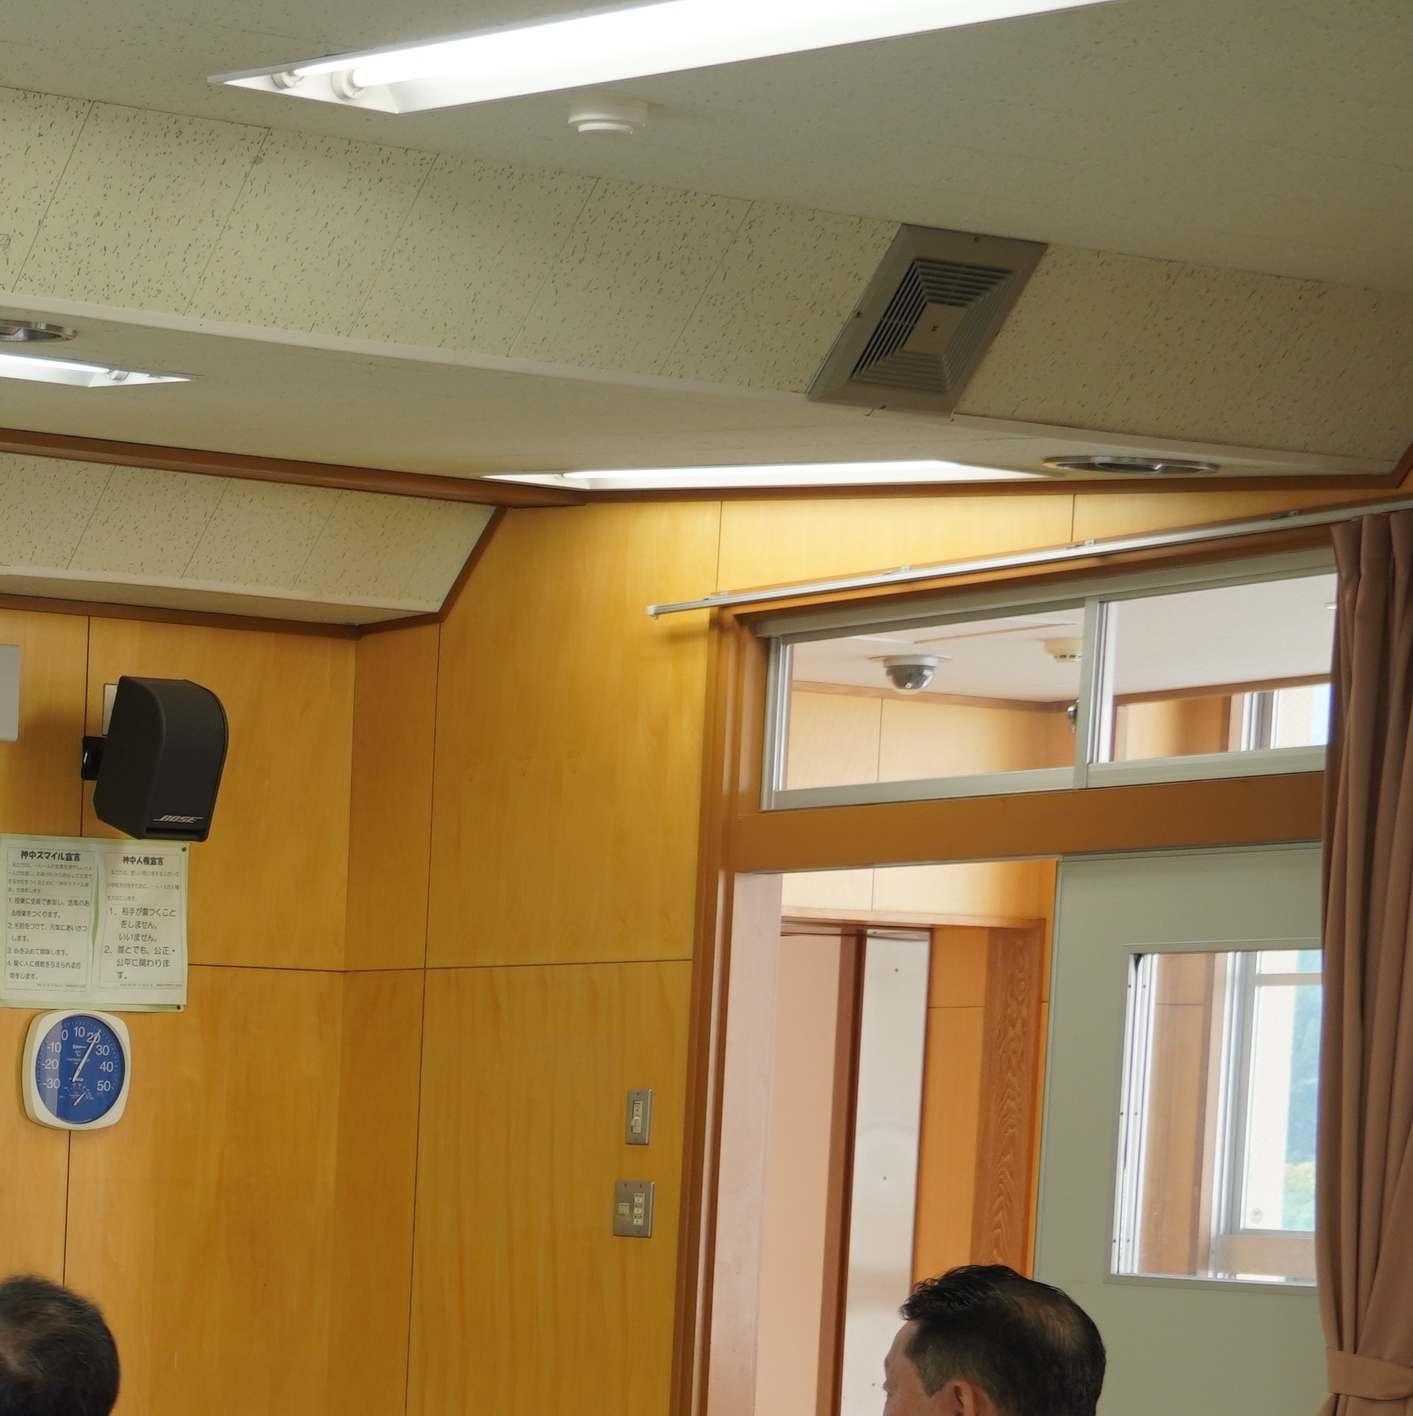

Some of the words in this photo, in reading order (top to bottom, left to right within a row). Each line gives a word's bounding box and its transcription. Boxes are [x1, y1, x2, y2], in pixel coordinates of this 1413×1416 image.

[155, 815, 203, 824] BOSE
[62, 1030, 68, 1040] 0
[74, 1026, 86, 1038] 10
[86, 1032, 101, 1043] 20
[47, 1042, 62, 1053] -10
[96, 1044, 110, 1056] 30
[41, 1058, 58, 1070] -20
[100, 1062, 114, 1072] 40
[43, 1078, 60, 1089] -30
[97, 1080, 110, 1092] 50
